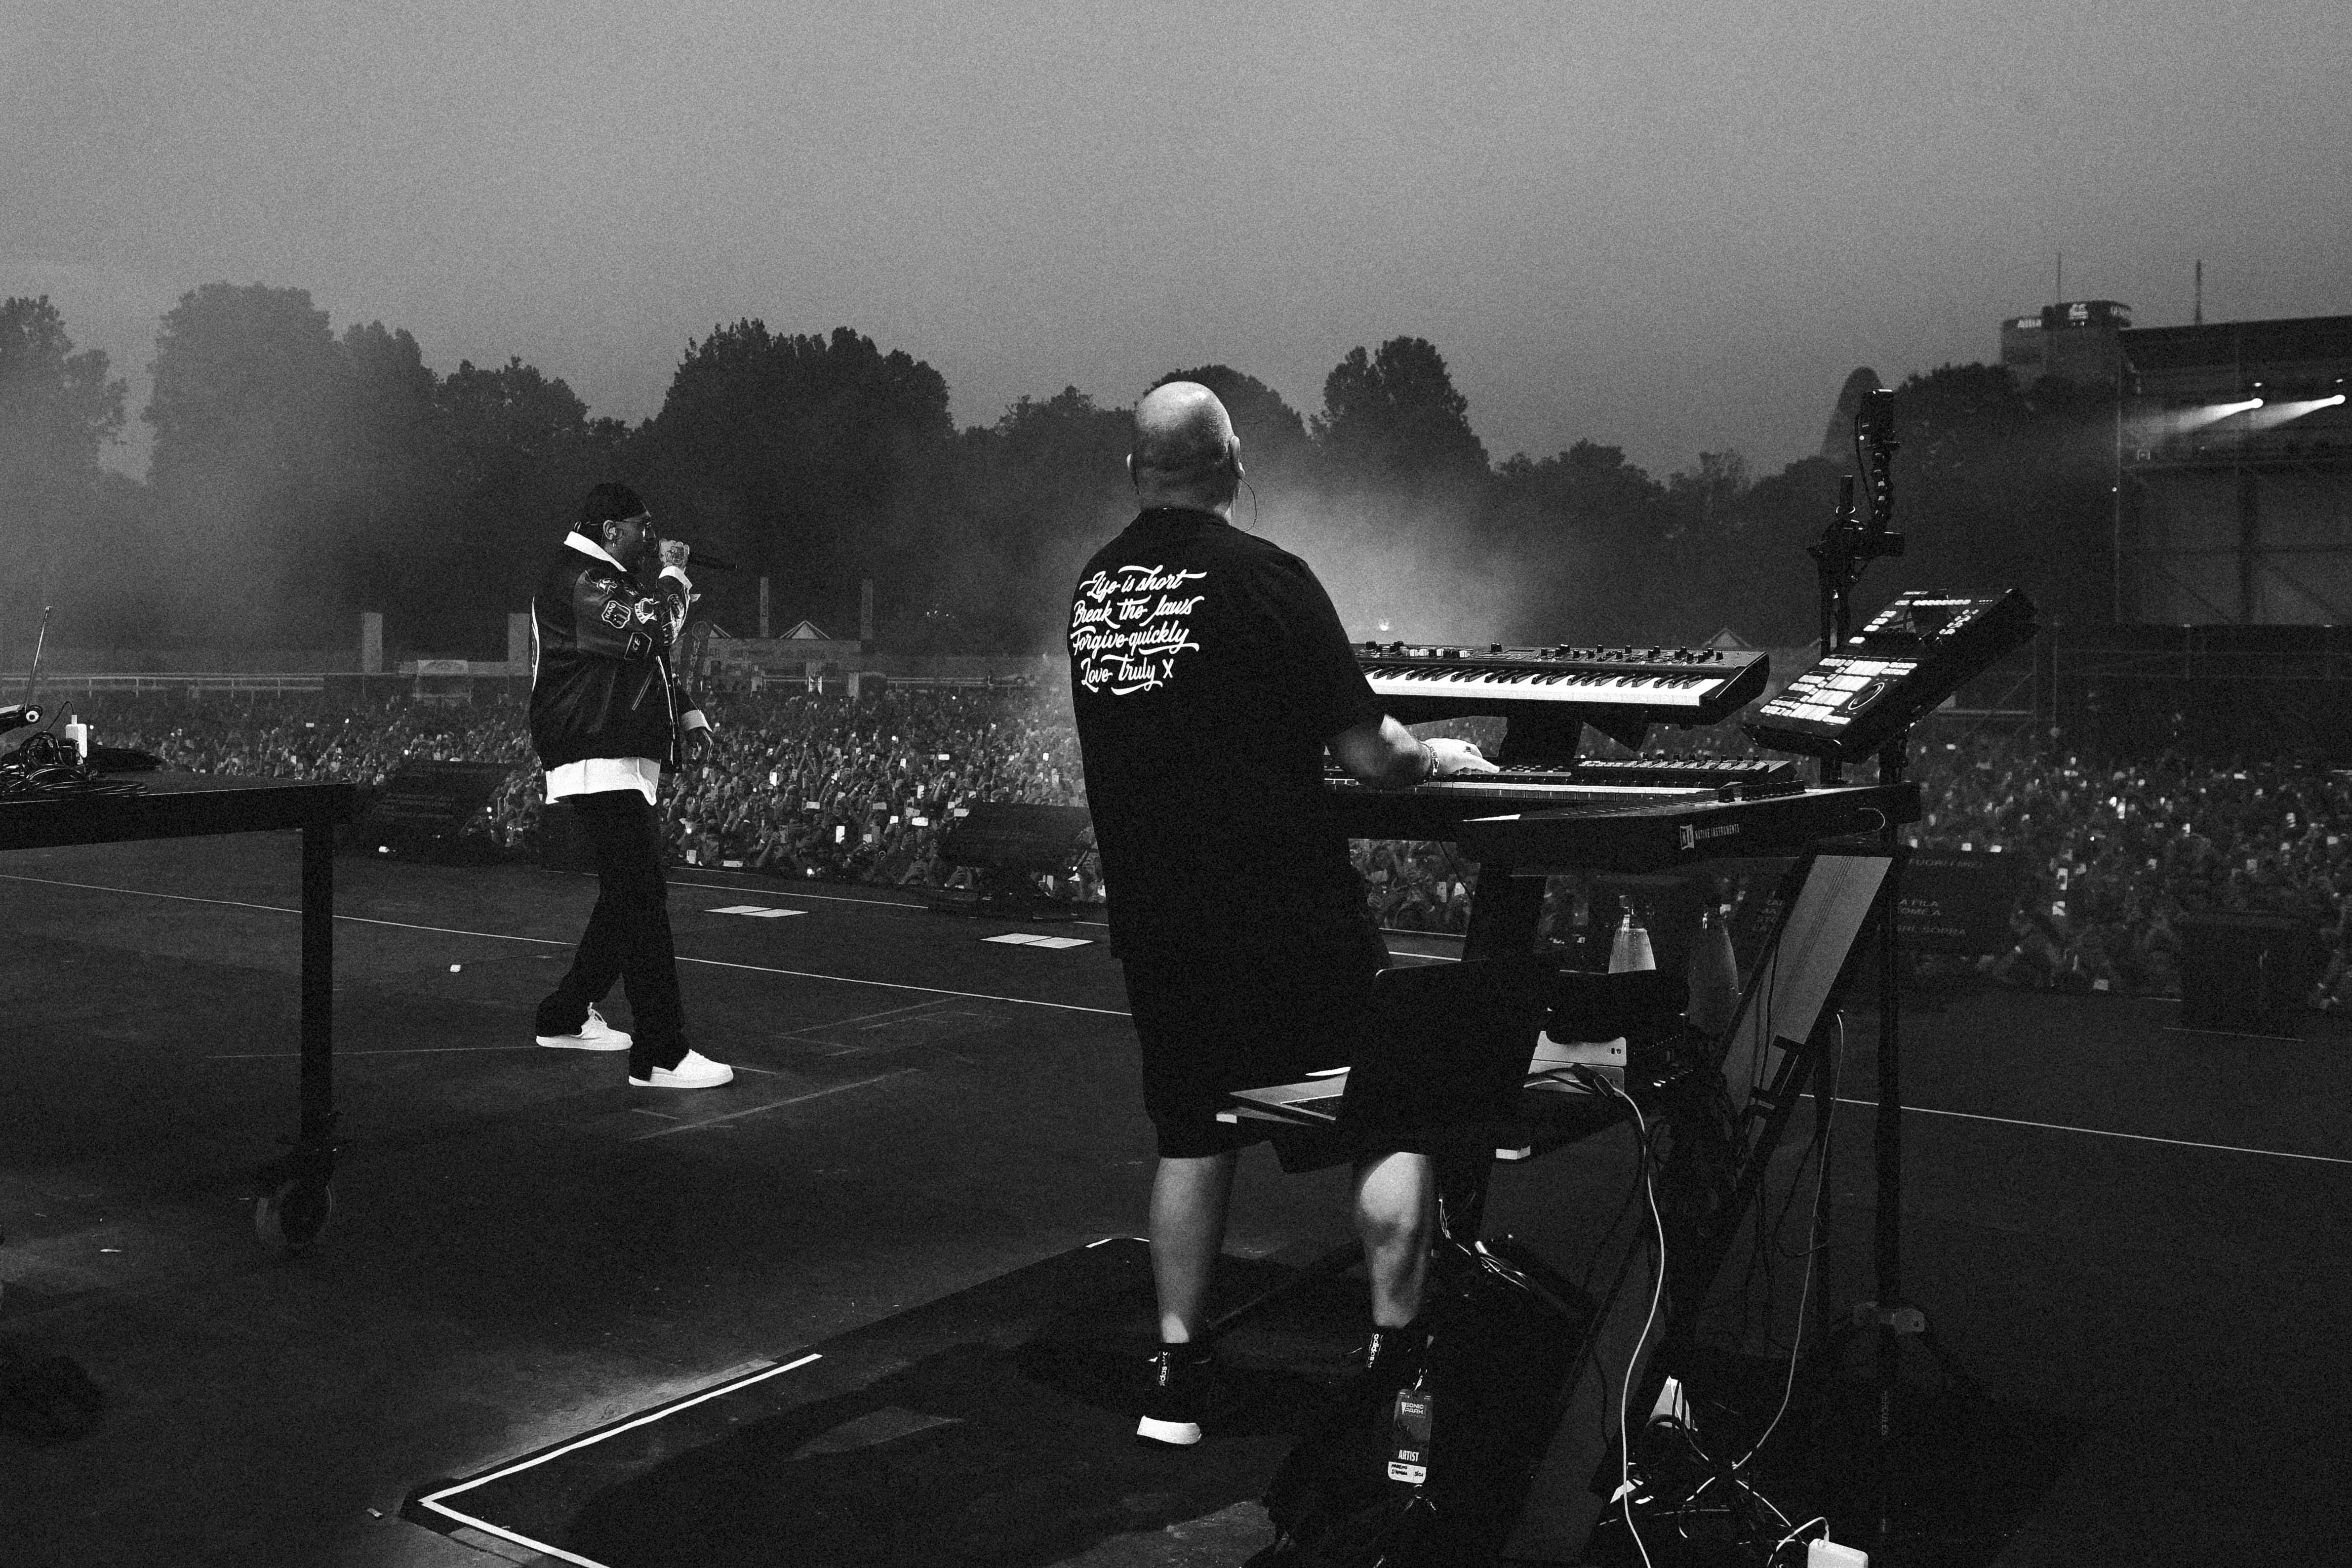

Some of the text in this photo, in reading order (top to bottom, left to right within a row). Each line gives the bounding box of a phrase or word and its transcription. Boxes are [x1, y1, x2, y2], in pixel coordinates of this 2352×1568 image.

[1079, 565, 1207, 603] Life is short
[1073, 595, 1205, 629] Break the laws
[1071, 620, 1199, 659] Forgive quickly
[1081, 658, 1113, 693] Love
[1101, 654, 1163, 695] truly
[1369, 1333, 1379, 1361] adidas
[1398, 1449, 1420, 1462] ARTIST
